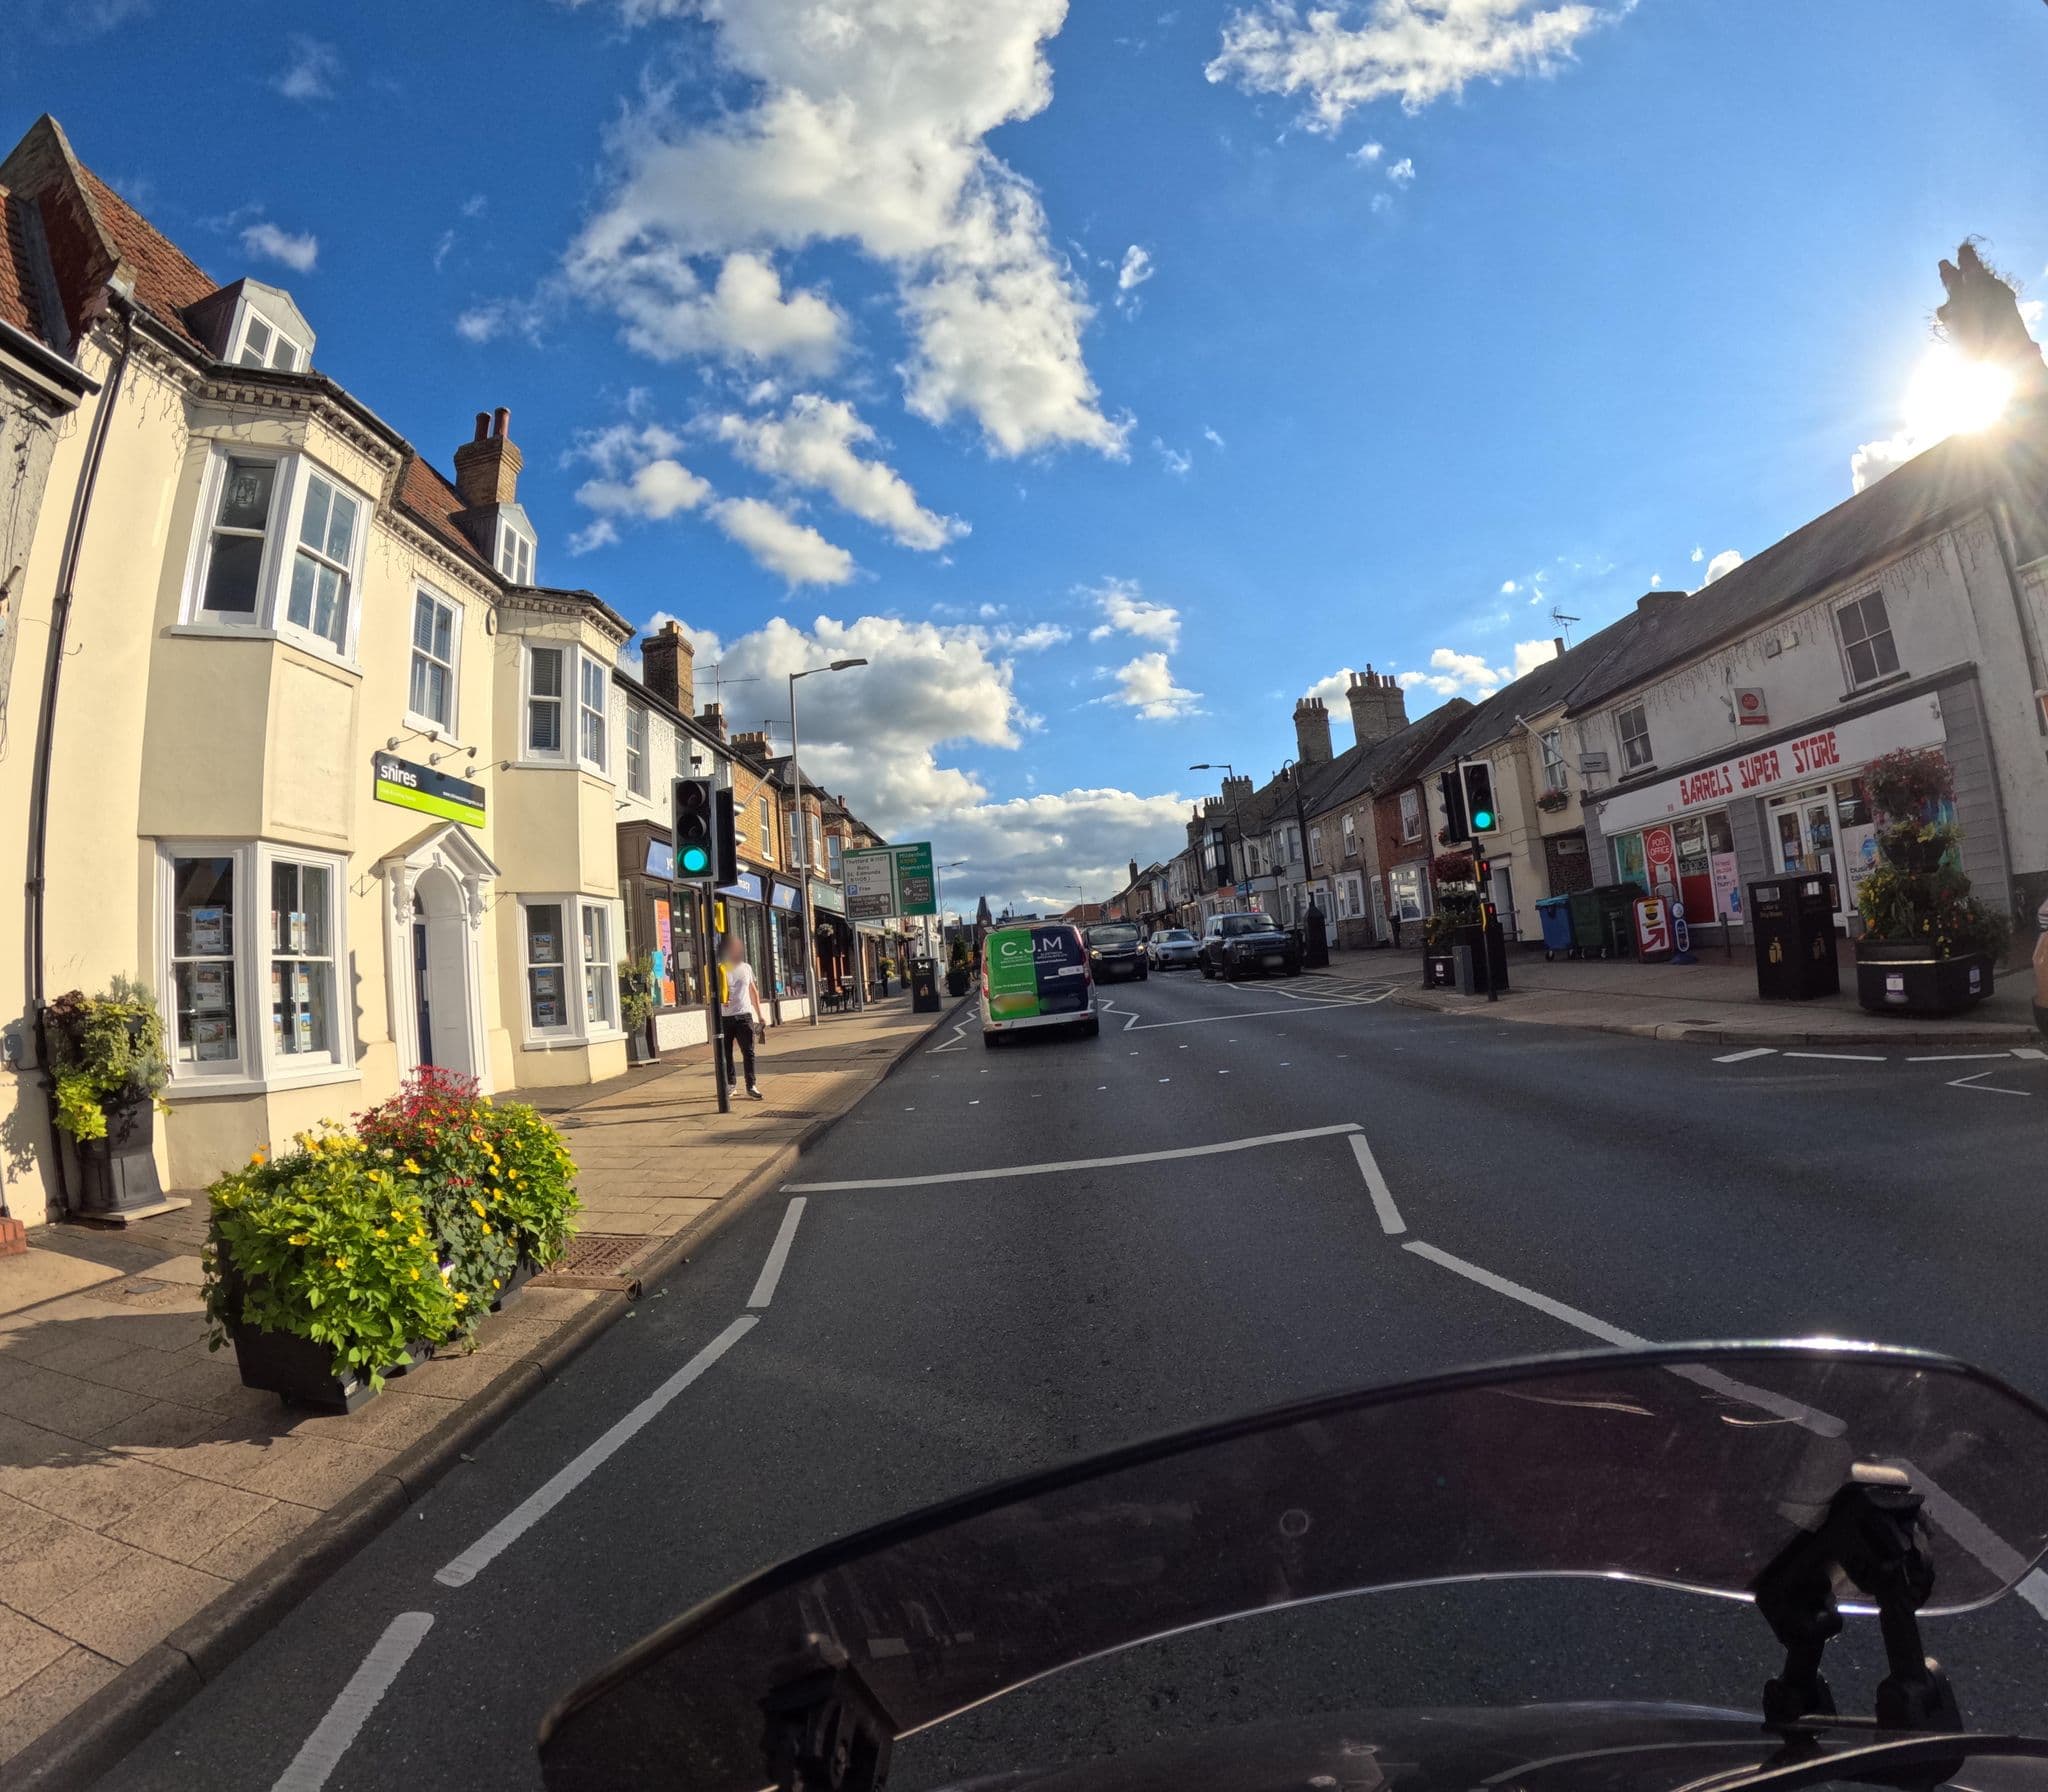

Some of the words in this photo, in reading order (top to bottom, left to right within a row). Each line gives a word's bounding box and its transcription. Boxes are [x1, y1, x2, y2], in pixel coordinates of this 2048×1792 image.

[1680, 765, 1733, 805] BARRELS
[1738, 750, 1781, 788] SUPER
[1792, 731, 1840, 773] STORE
[1652, 838, 1666, 846] POST
[1650, 847, 1670, 856] OFFICE
